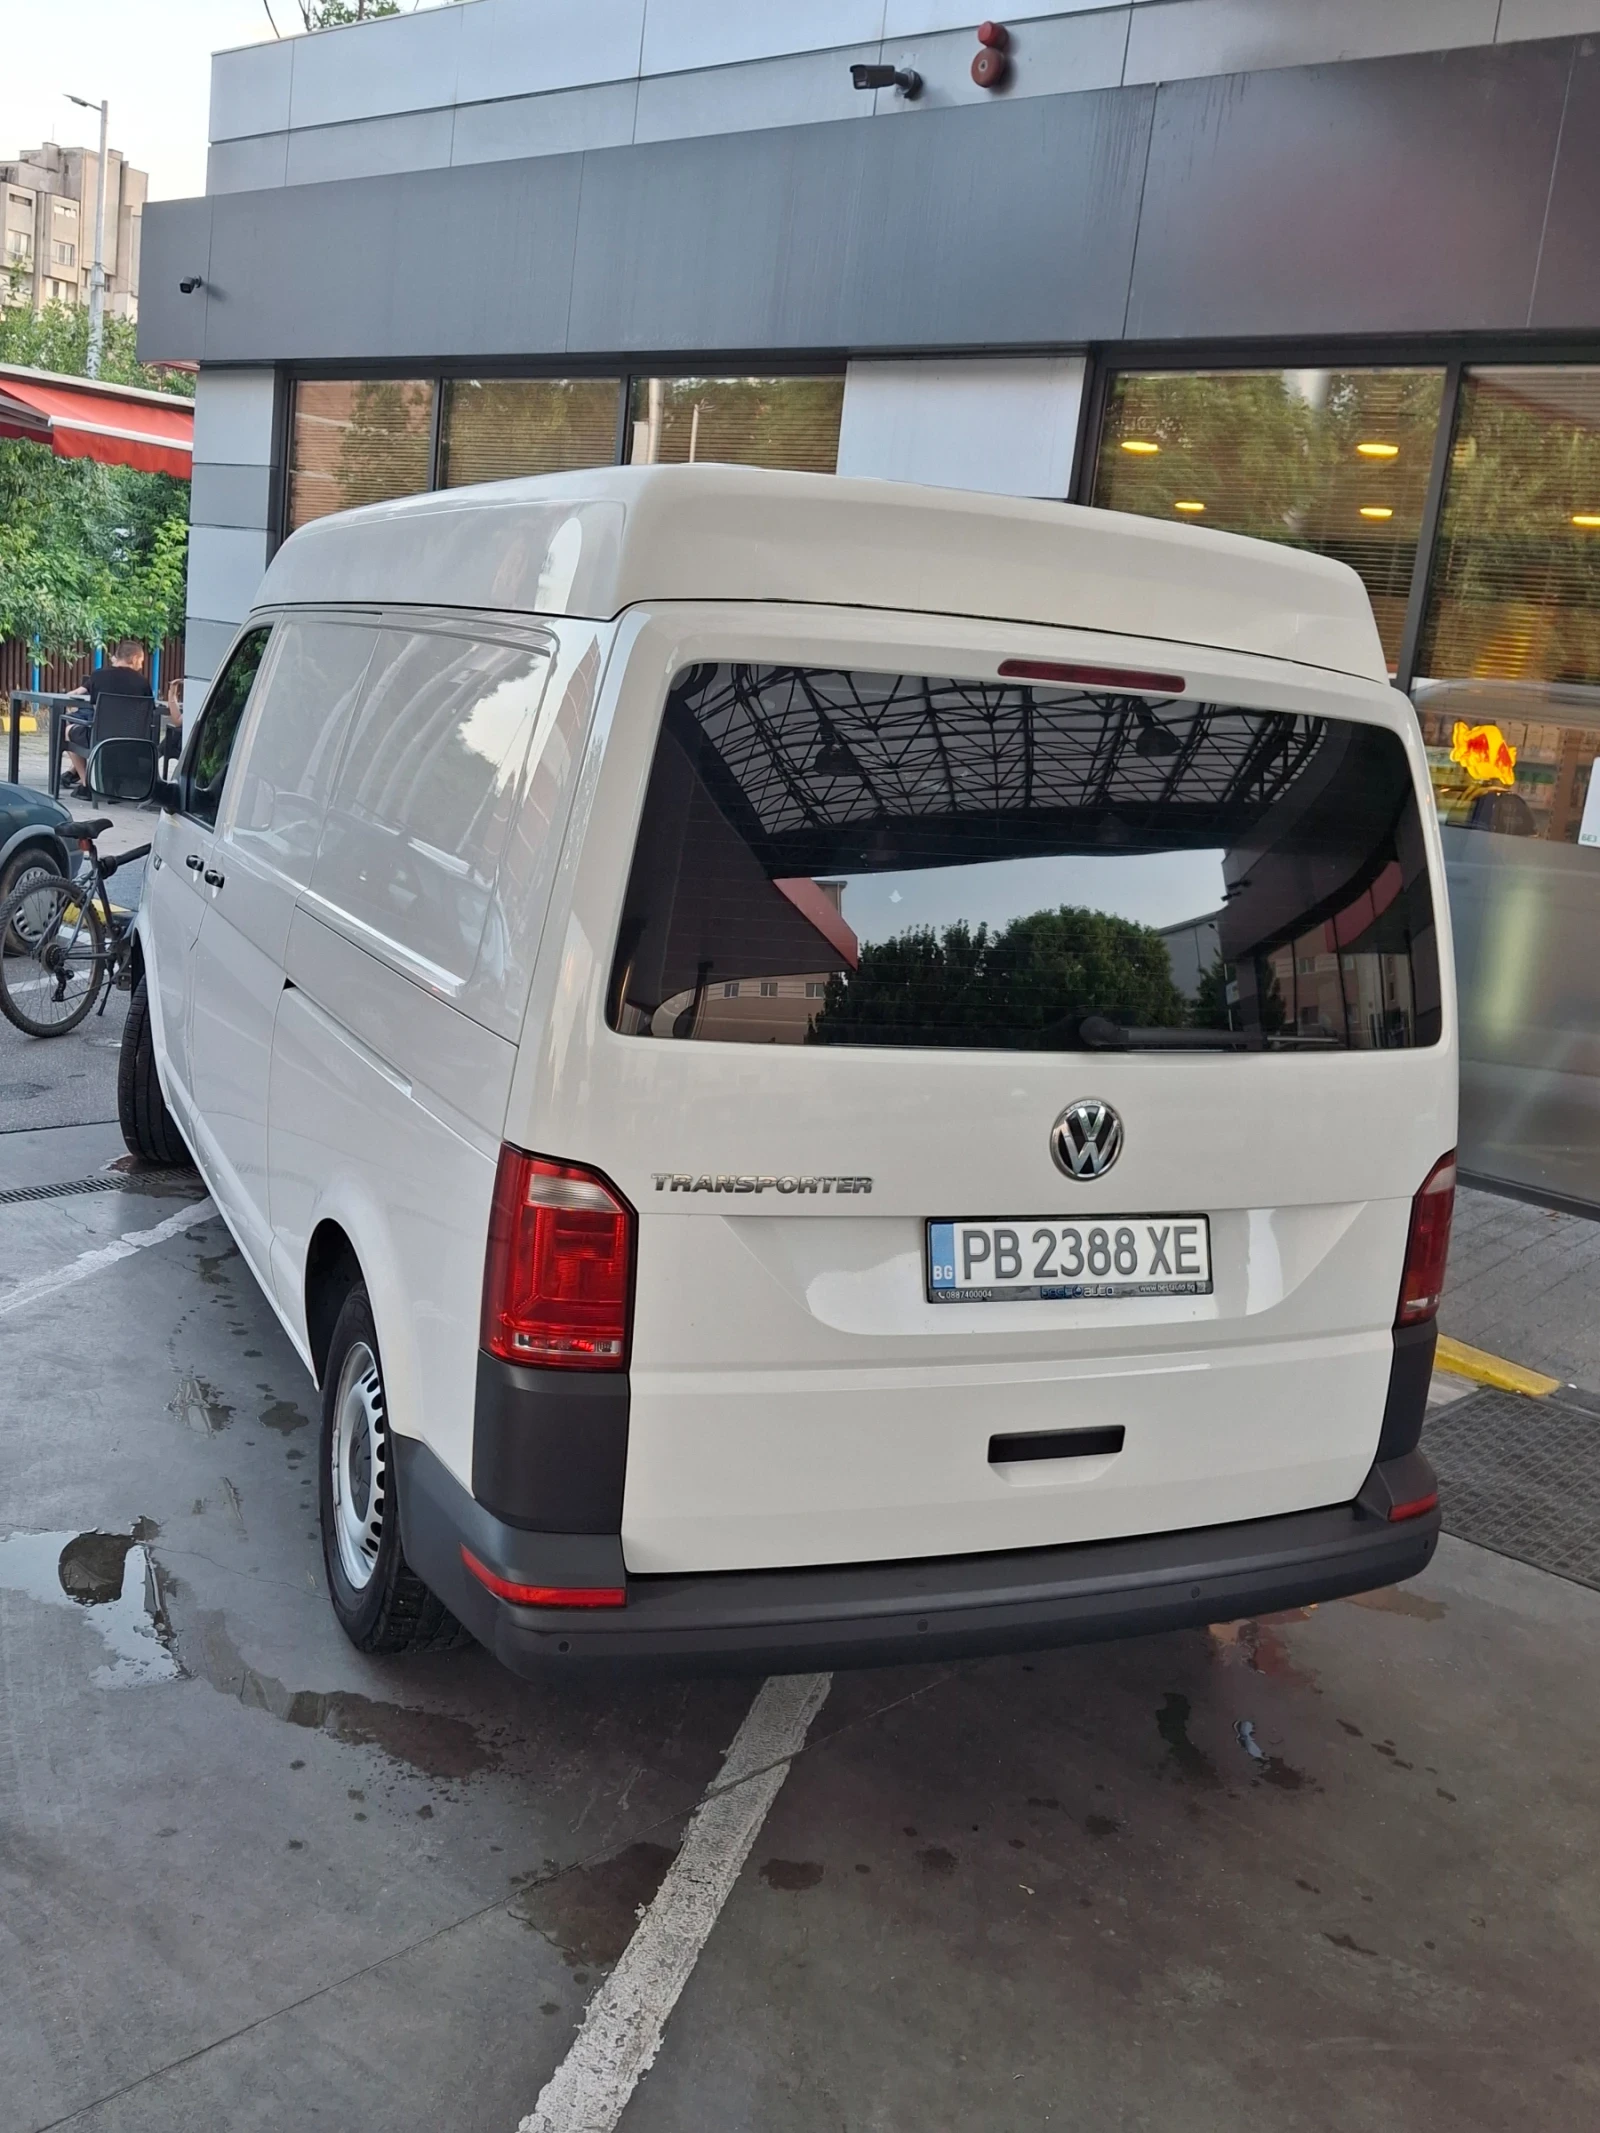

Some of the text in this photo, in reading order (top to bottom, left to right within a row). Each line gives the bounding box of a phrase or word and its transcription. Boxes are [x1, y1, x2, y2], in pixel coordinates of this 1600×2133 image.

[651, 1173, 873, 1194] TRANSPORTER
[962, 1226, 1201, 1280] PB 2388 XE
[932, 1265, 953, 1280] BG
